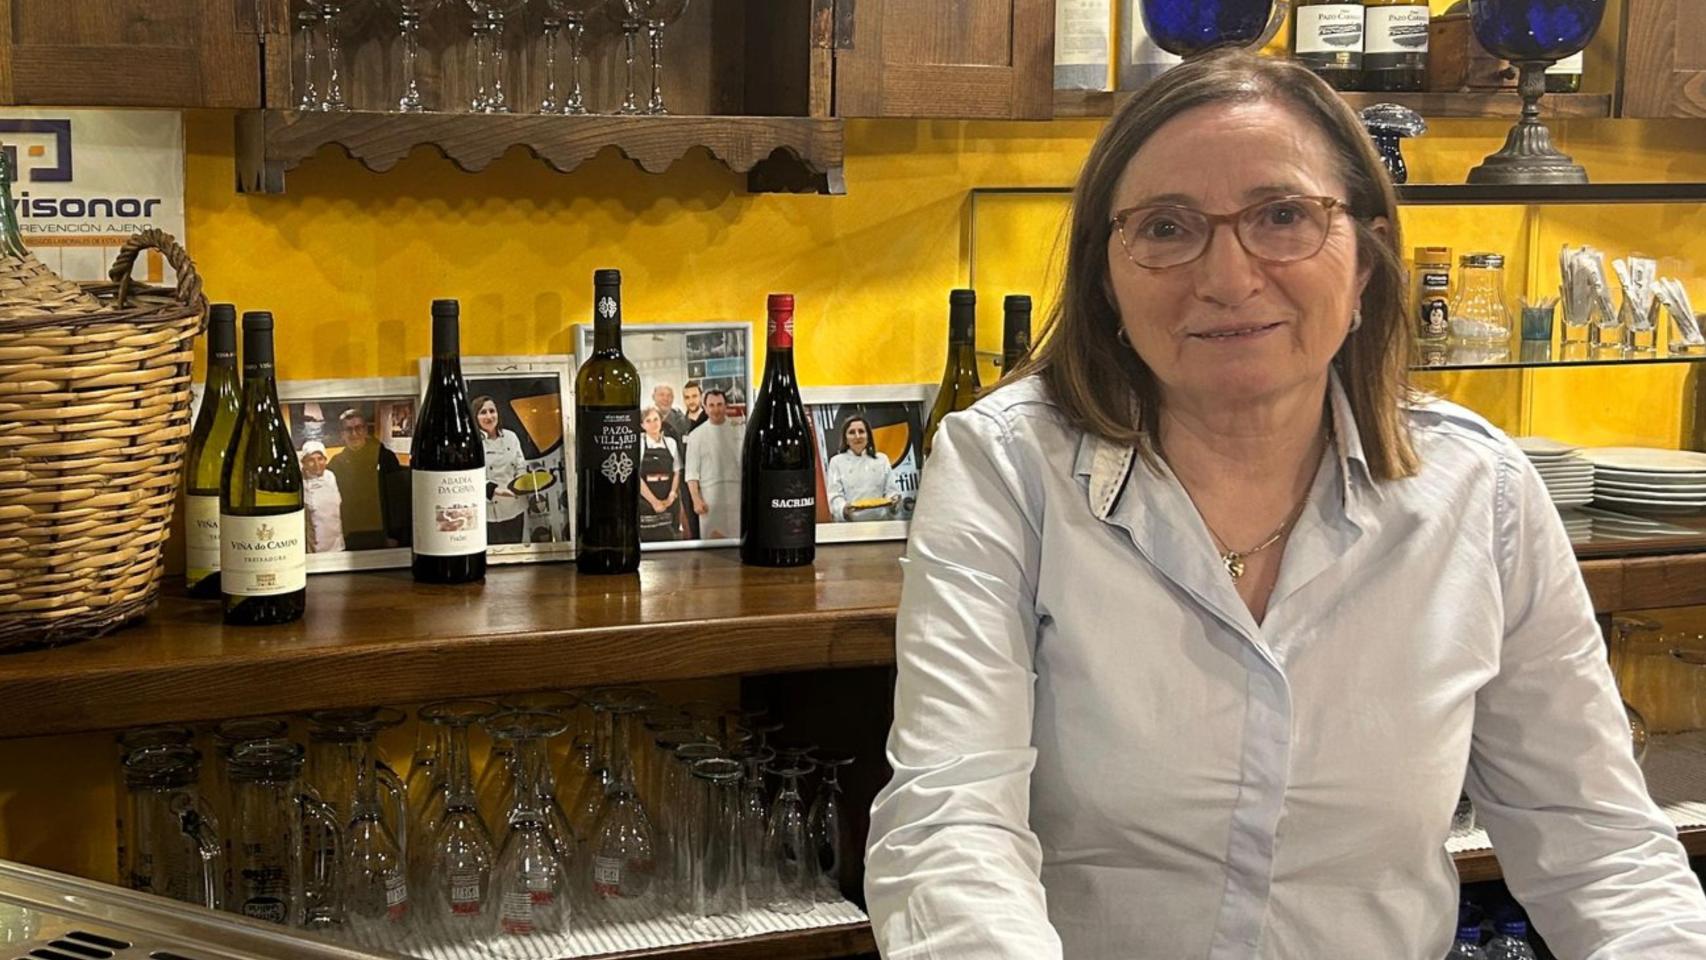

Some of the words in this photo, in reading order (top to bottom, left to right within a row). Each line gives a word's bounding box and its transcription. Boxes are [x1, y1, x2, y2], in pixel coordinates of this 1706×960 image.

[602, 426, 628, 435] PAZO
[254, 542, 266, 551] do
[267, 538, 298, 551] CAMPO
